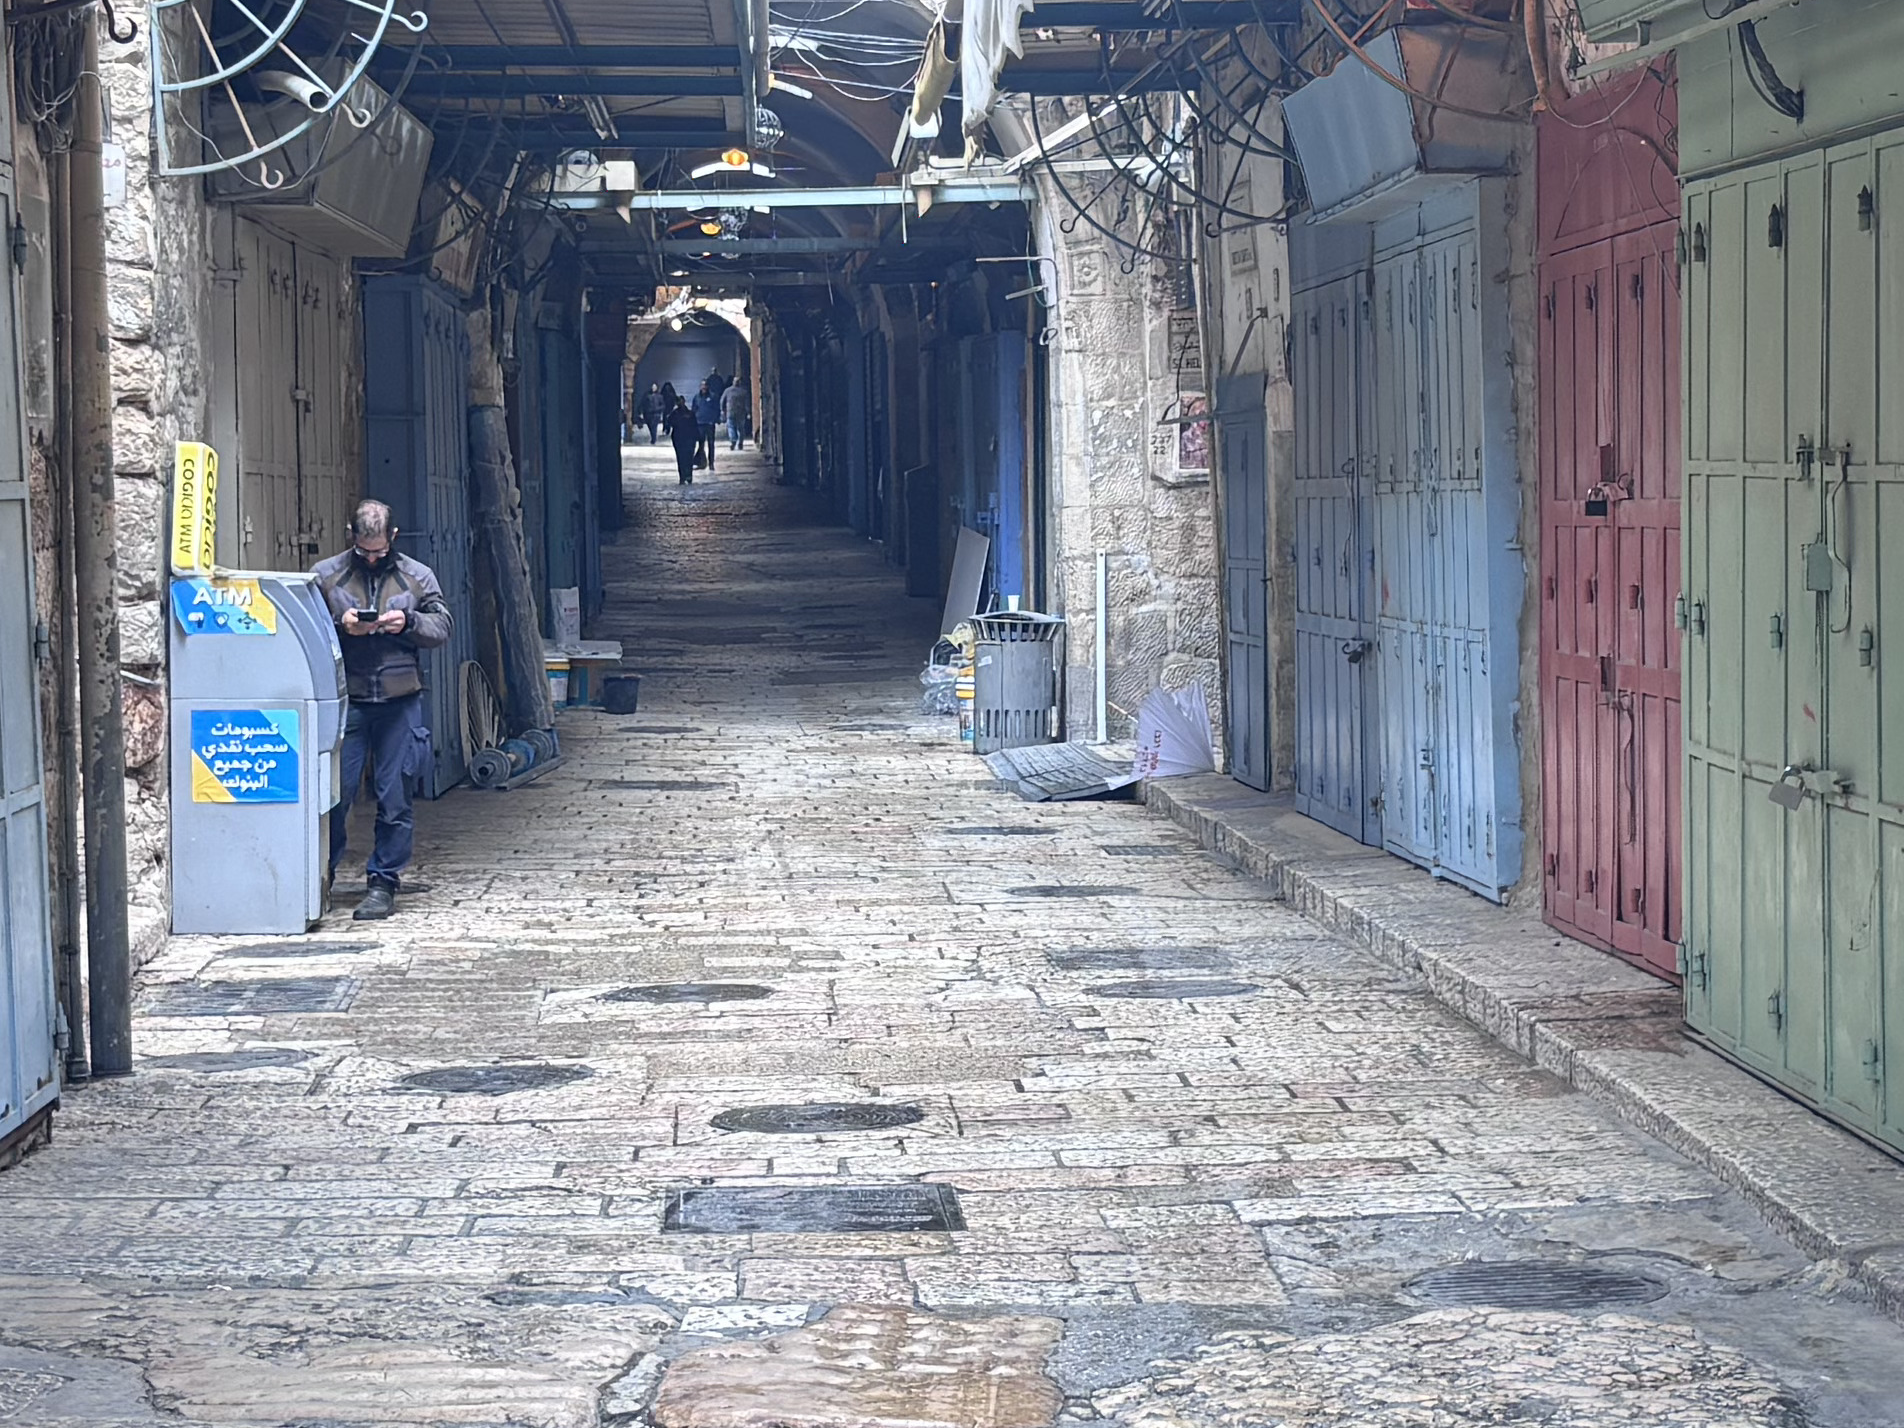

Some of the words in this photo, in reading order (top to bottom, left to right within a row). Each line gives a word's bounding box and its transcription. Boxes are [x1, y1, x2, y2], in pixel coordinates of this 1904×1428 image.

[179, 524, 192, 554] ATM
[192, 586, 253, 606] ATM
[202, 740, 243, 759] نقدي
[245, 743, 288, 756] سحب
[213, 759, 252, 775] جميع
[254, 758, 277, 773] من
[222, 774, 268, 792] البنوك
